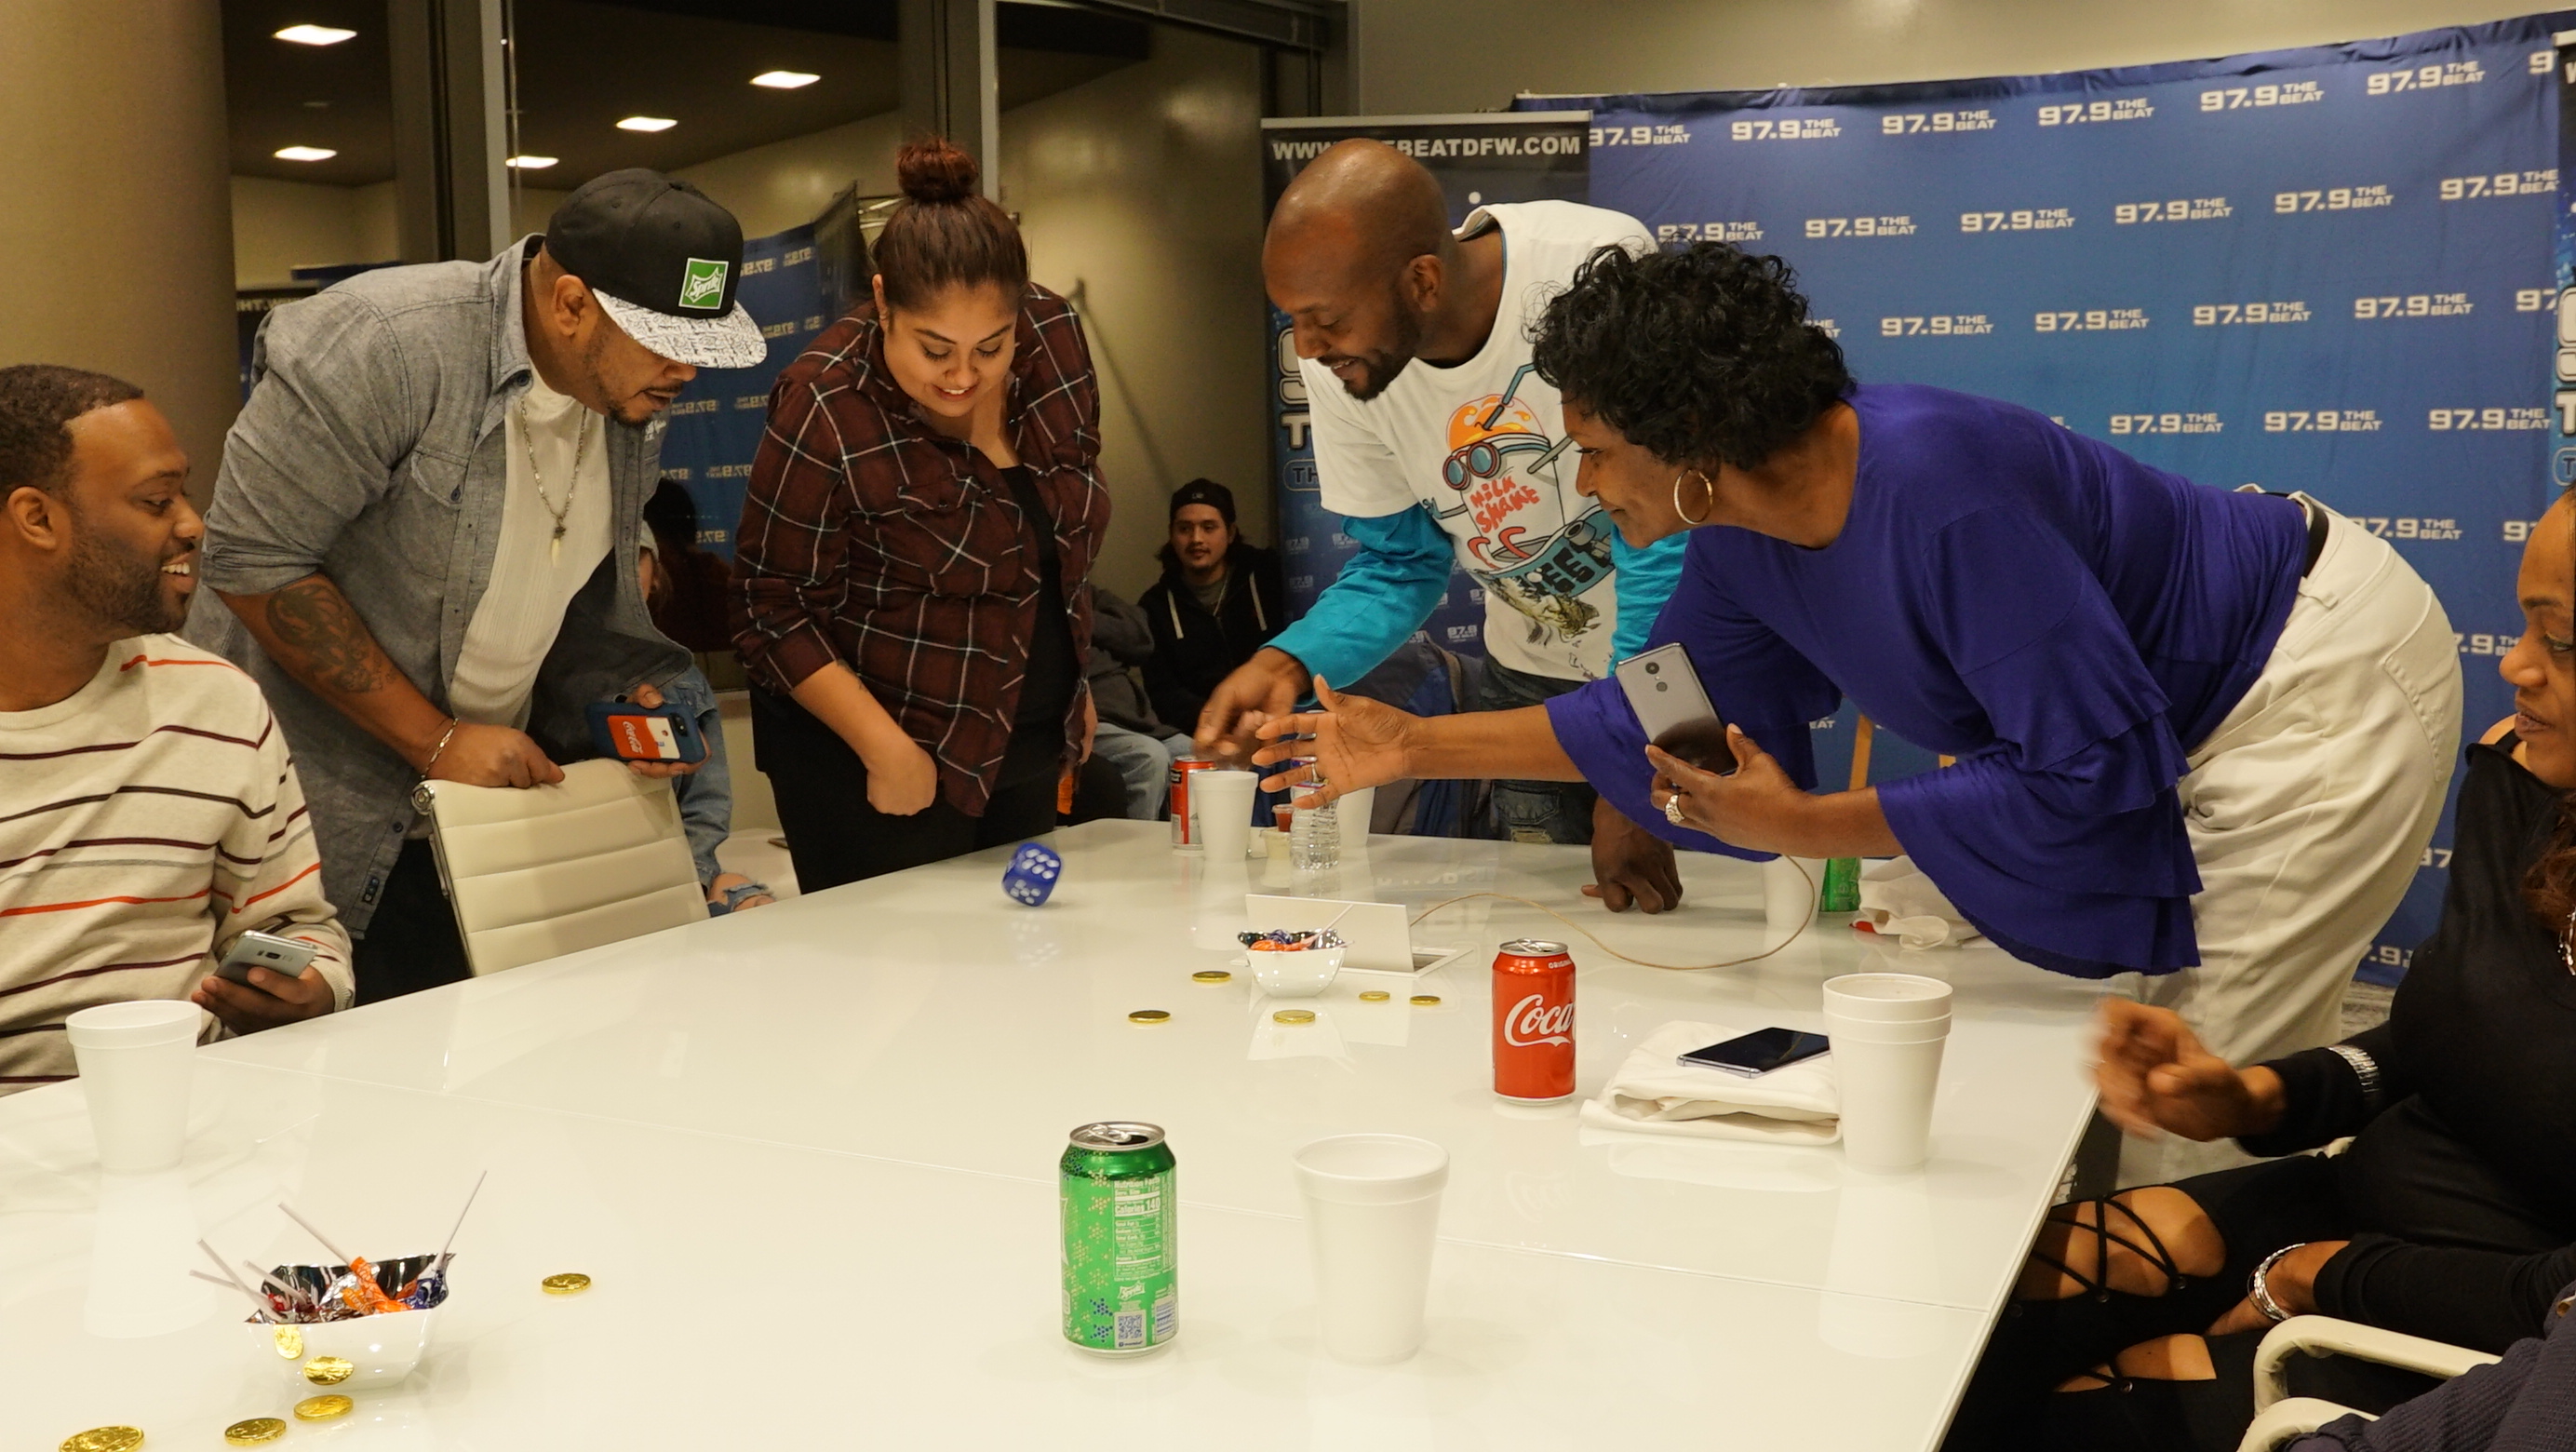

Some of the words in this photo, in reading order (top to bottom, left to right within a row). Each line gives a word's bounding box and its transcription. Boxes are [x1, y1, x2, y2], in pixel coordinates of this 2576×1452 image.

[2448, 61, 2477, 74] THE
[2368, 66, 2442, 94] 97.9
[2443, 72, 2485, 86] BEAT
[2285, 81, 2317, 94] THE
[2201, 86, 2279, 112] 97.9
[2280, 91, 2324, 105] BEAT
[2116, 99, 2147, 110] THE
[1959, 111, 1989, 120] THE
[2039, 101, 2112, 126] 97.9
[2113, 107, 2154, 120] BEAT
[1805, 119, 1833, 128] THE
[1883, 113, 1953, 133] 97.9
[1955, 120, 1996, 130] BEAT
[1656, 125, 1684, 134] THE
[1732, 120, 1800, 141] 97.9
[1802, 128, 1841, 139] BEAT
[1590, 127, 1651, 146] 97.9
[1653, 135, 1690, 144] BEAT
[2357, 185, 2387, 197] THE
[2440, 173, 2518, 201] 97.9
[2194, 197, 2226, 209] THE
[2275, 189, 2351, 214] 97.9
[2352, 195, 2394, 208] BEAT
[2038, 208, 2069, 219] THE
[2115, 200, 2189, 224] 97.9
[2190, 208, 2233, 220] BEAT
[1729, 222, 1756, 230] THE
[1880, 216, 1910, 225] THE
[1961, 210, 2033, 233] 97.9
[2034, 218, 2075, 229] BEAT
[1658, 222, 1724, 242] 97.9
[1805, 218, 1875, 237] 97.9
[1877, 225, 1917, 235] BEAT
[1726, 230, 1764, 241] BEAT
[2435, 293, 2467, 305] THE
[2274, 302, 2305, 313] THE
[2355, 296, 2431, 319] 97.9
[2431, 303, 2474, 316] BEAT
[1956, 315, 1986, 324] THE
[2113, 309, 2142, 319] THE
[2194, 304, 2269, 326] 97.9
[2270, 311, 2312, 323] BEAT
[1882, 316, 1952, 336] 97.9
[2035, 311, 2108, 332] 97.9
[2109, 319, 2149, 329] BEAT
[1953, 324, 1993, 334] BEAT
[2186, 412, 2217, 423] THE
[2345, 410, 2376, 421] THE
[2430, 408, 2506, 430] 97.9
[2512, 408, 2545, 418] THE
[2110, 414, 2181, 434] 97.9
[2264, 410, 2339, 432] 97.9
[2341, 421, 2382, 432] BEAT
[2507, 418, 2551, 430] BEAT
[2183, 423, 2223, 433] BEAT
[2423, 519, 2455, 529] THE
[2420, 529, 2462, 540] BEAT
[1146, 1197, 1161, 1211] 140
